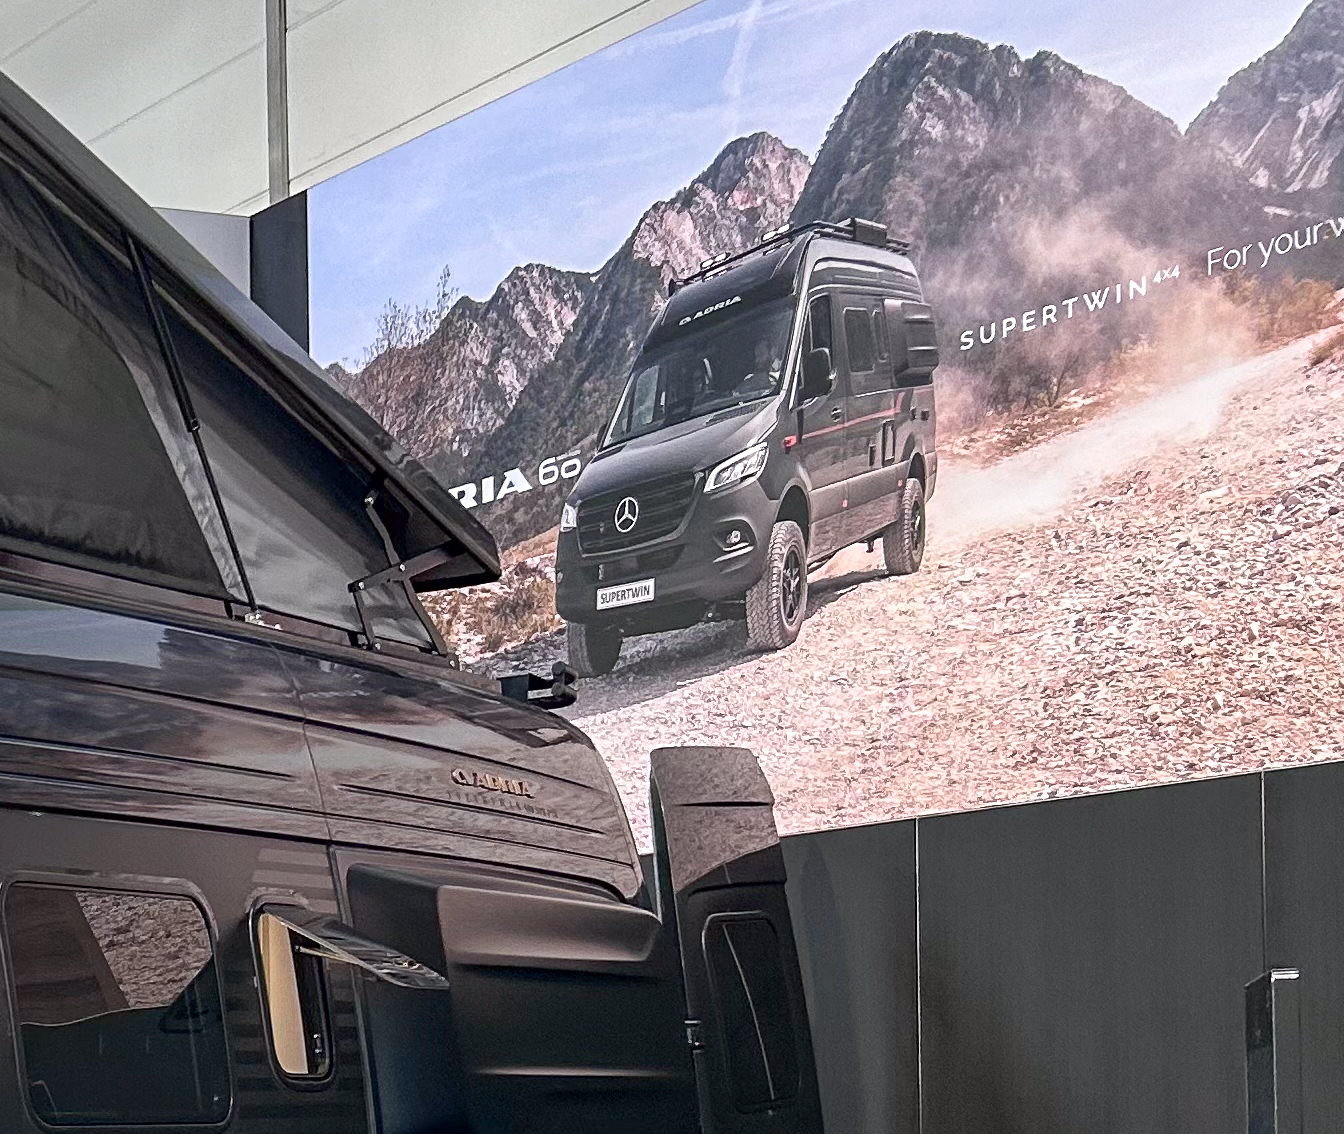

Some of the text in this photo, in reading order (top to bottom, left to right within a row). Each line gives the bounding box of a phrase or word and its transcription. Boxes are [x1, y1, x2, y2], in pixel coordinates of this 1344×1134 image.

[960, 275, 1147, 351] SUPERTWIN
[1207, 247, 1253, 275] For
[1257, 222, 1324, 267] your
[448, 456, 582, 509] RIA 60
[600, 584, 651, 605] SUPERTWIN
